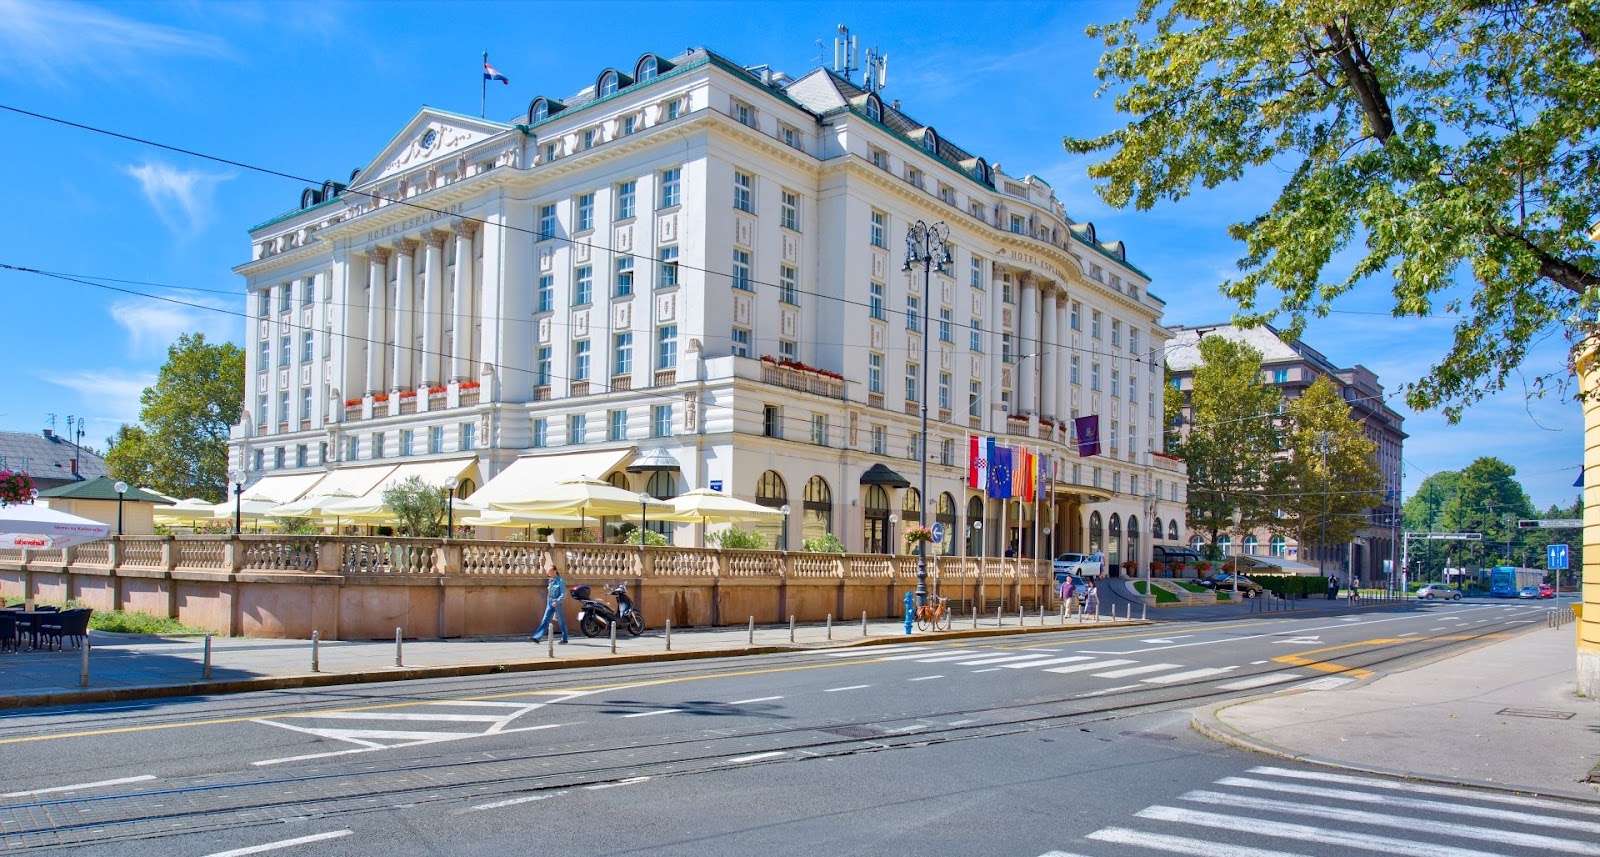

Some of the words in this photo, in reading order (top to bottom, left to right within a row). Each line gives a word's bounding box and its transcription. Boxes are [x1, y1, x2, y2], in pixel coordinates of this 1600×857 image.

[367, 224, 398, 241] HOTEL
[402, 201, 464, 230] ESPLANADE
[1011, 250, 1039, 266] HOTEL
